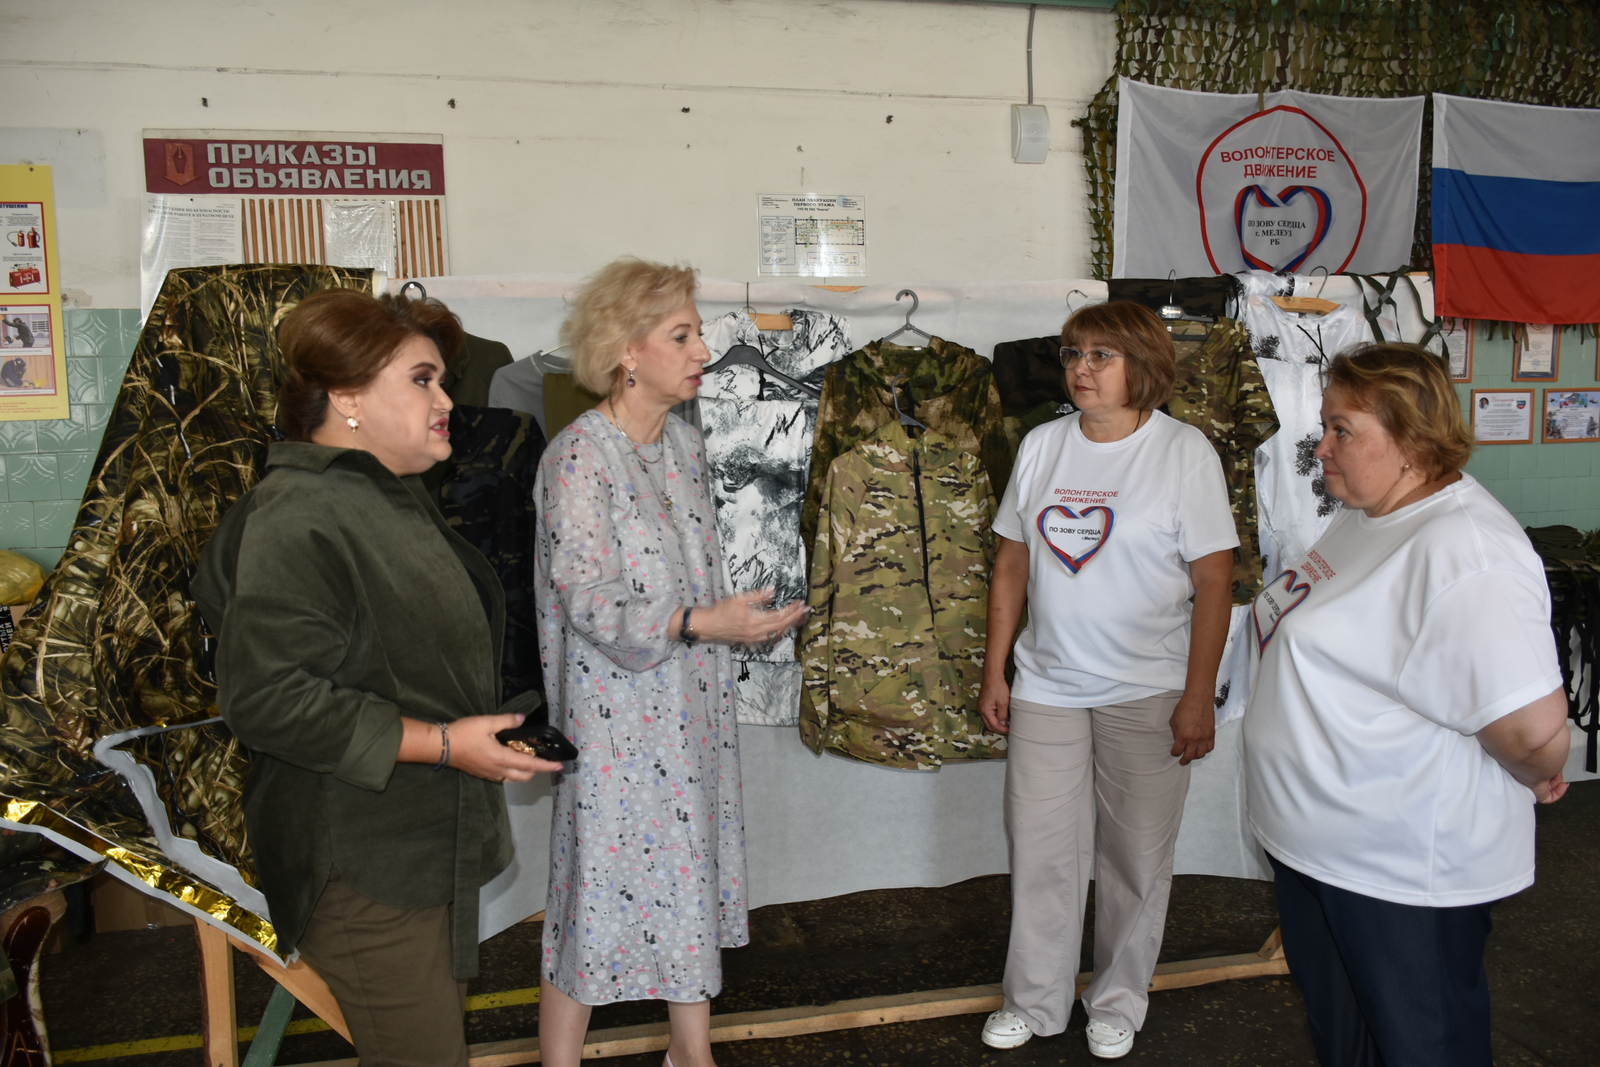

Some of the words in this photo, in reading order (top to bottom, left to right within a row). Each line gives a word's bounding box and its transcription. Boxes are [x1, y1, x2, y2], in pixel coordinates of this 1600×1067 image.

[206, 143, 376, 166] ПРИКАЗЫ
[1220, 146, 1336, 163] ВОЛОНТЕРСКОЕ
[208, 167, 432, 189] ОБЪЯВЛЕНИЯ
[1243, 163, 1318, 179] ДВИЖЕНИЕ
[1256, 220, 1275, 228] ЗОВУ
[1277, 220, 1306, 229] СЕРДЦА
[1054, 488, 1119, 498] ВОЛОНТЕРСКОЕ
[1059, 496, 1107, 504] ДВИЖЕНИЕ
[1307, 550, 1336, 580] ВОЛОНТЕРСКОЕ
